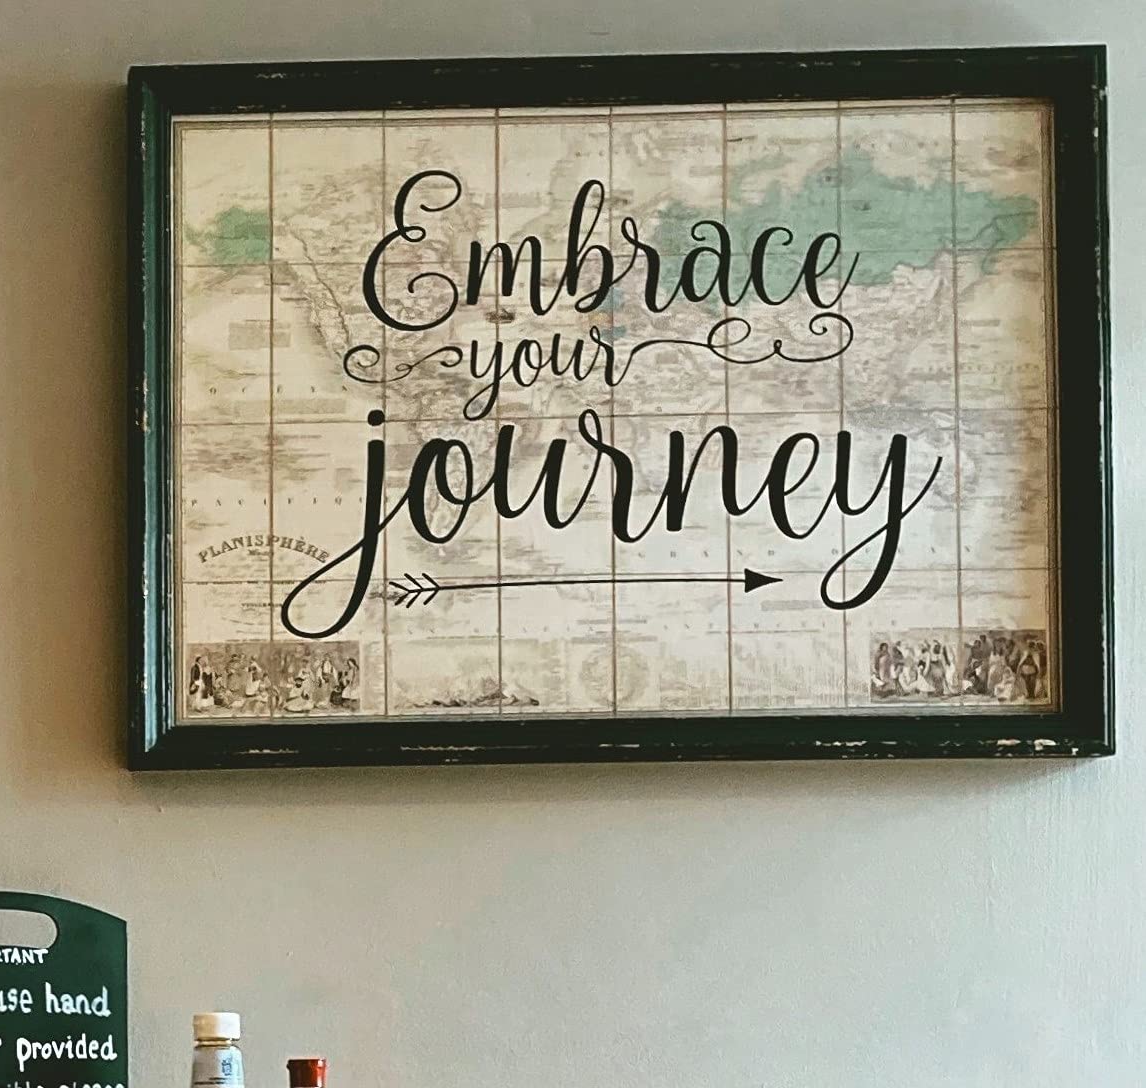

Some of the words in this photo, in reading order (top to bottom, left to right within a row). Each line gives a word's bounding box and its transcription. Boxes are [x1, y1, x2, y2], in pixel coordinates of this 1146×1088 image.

[362, 170, 860, 332] Embrace
[462, 324, 639, 421] your
[280, 408, 943, 639] journey
[45, 981, 111, 1018] hand
[16, 1032, 118, 1073] provided
